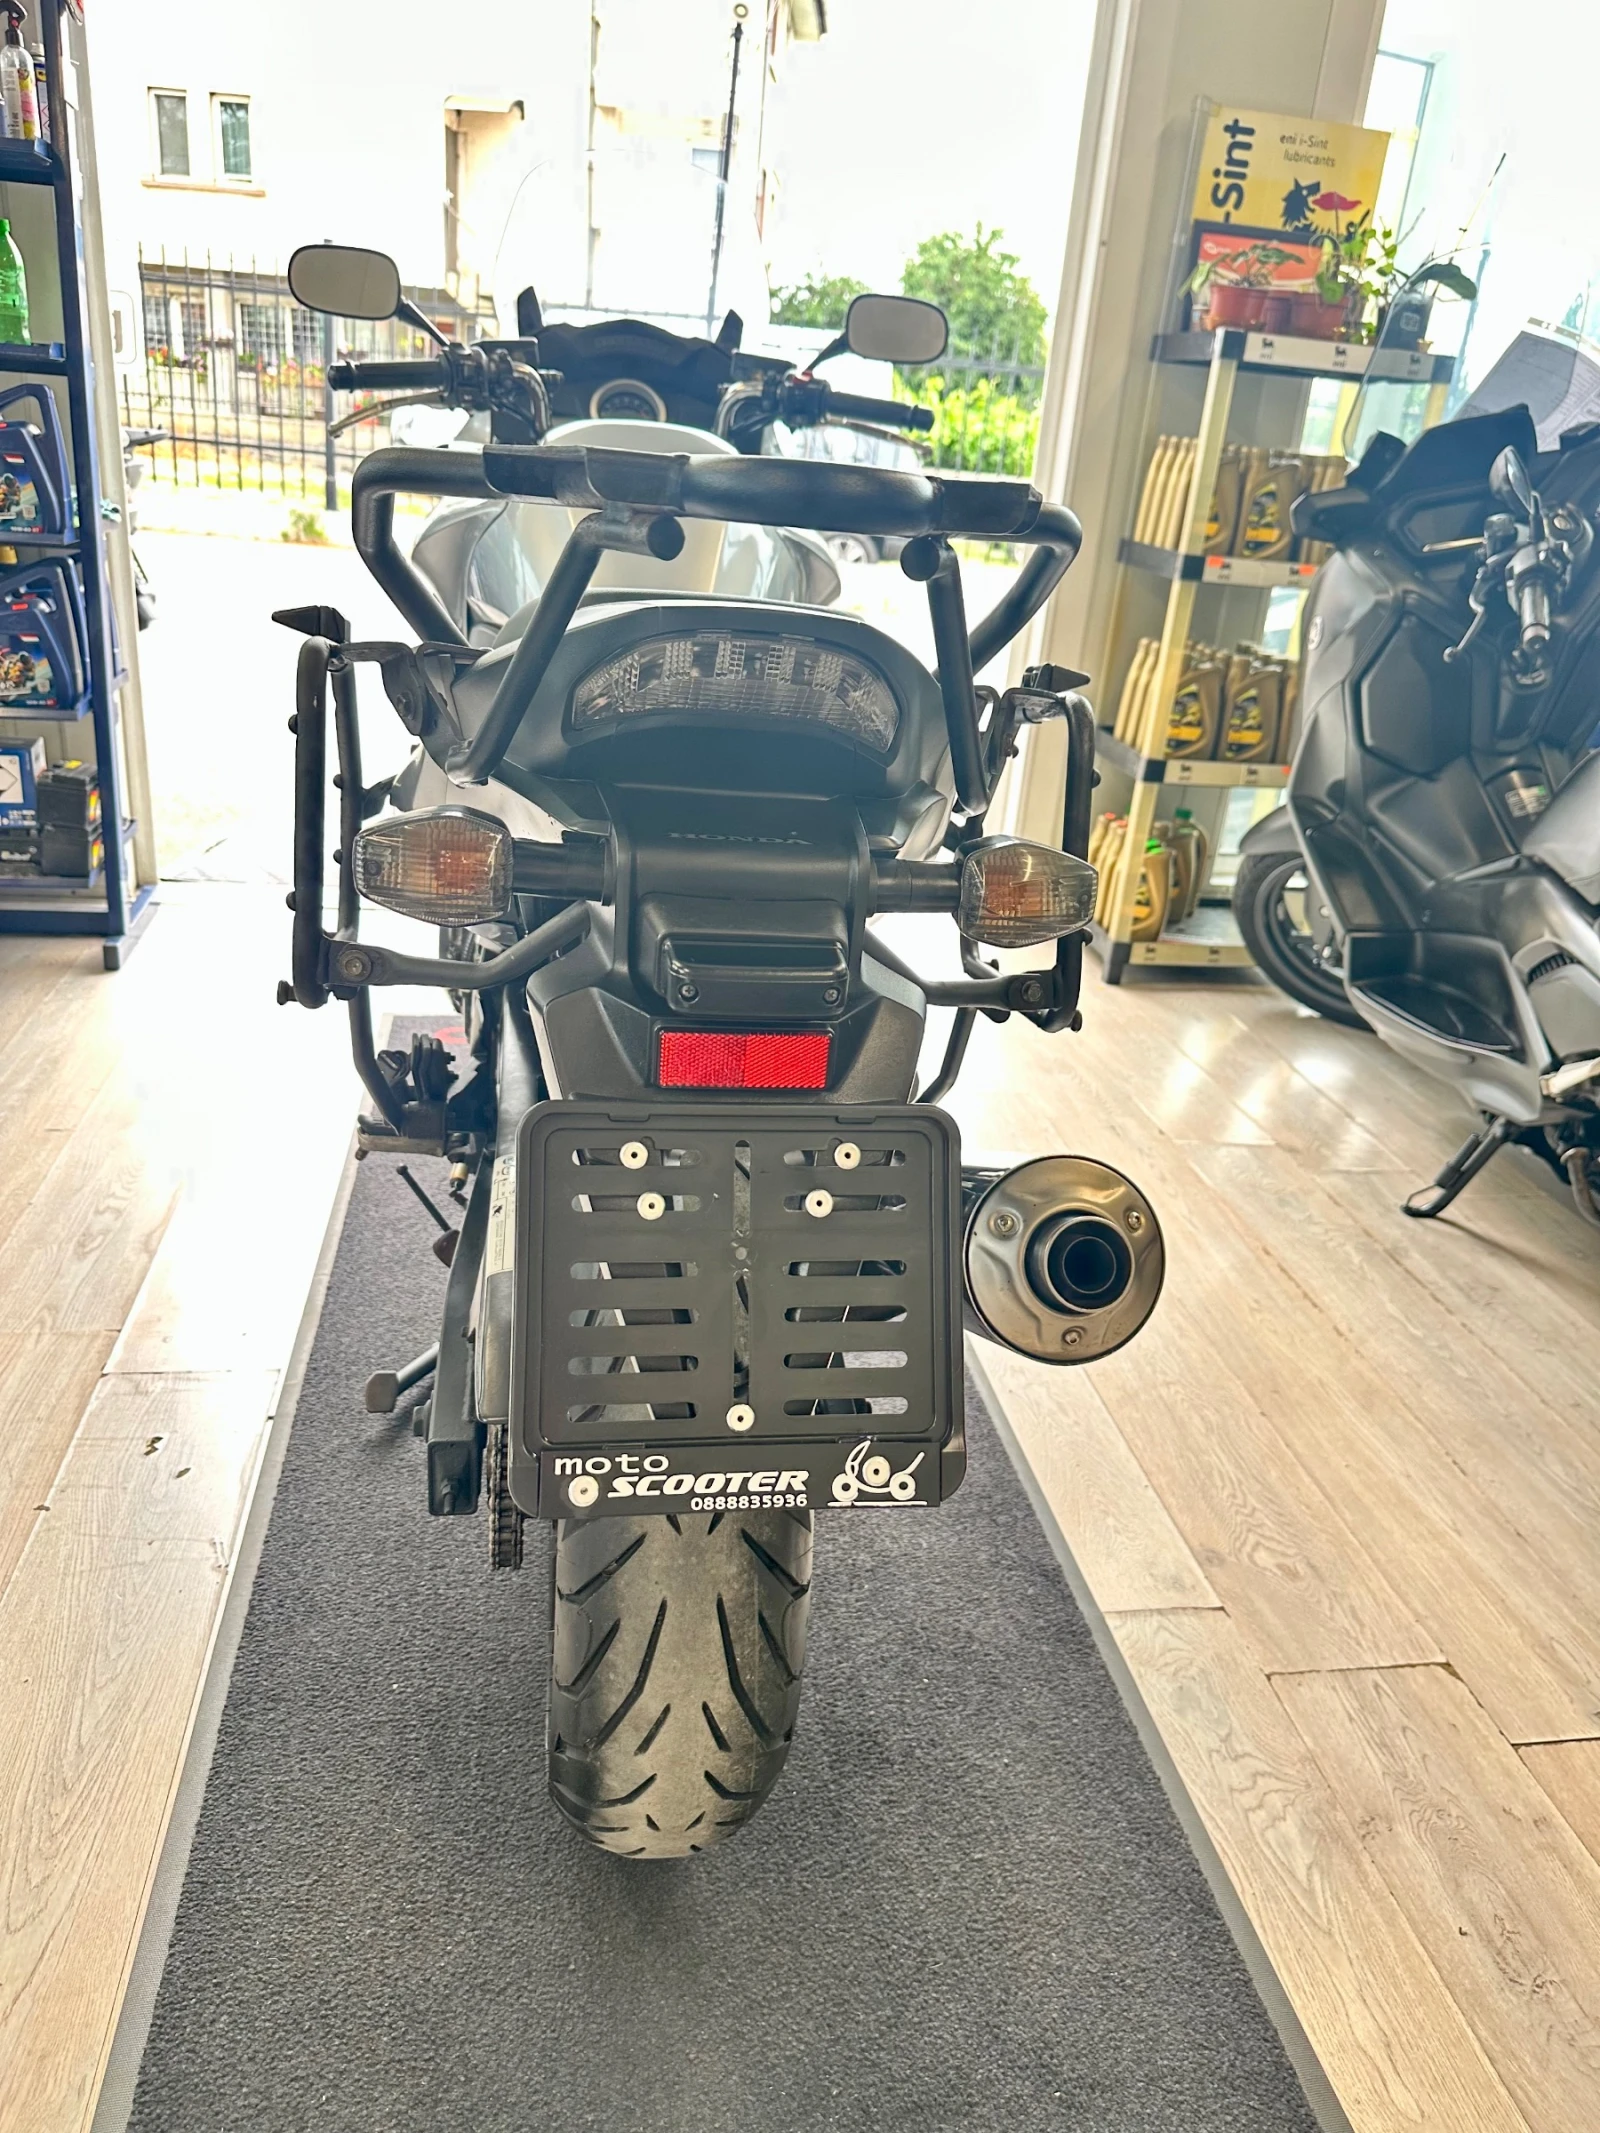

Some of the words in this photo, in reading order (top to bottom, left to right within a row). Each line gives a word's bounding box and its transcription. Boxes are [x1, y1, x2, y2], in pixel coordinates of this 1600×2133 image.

[1280, 133, 1298, 145] eni
[1299, 133, 1329, 150] i-Sint
[1283, 149, 1337, 168] lubricants
[667, 832, 813, 845] HONDA
[554, 1454, 669, 1475] moto
[607, 1470, 810, 1498] SCOOTER
[690, 1493, 808, 1511] 0888835936
